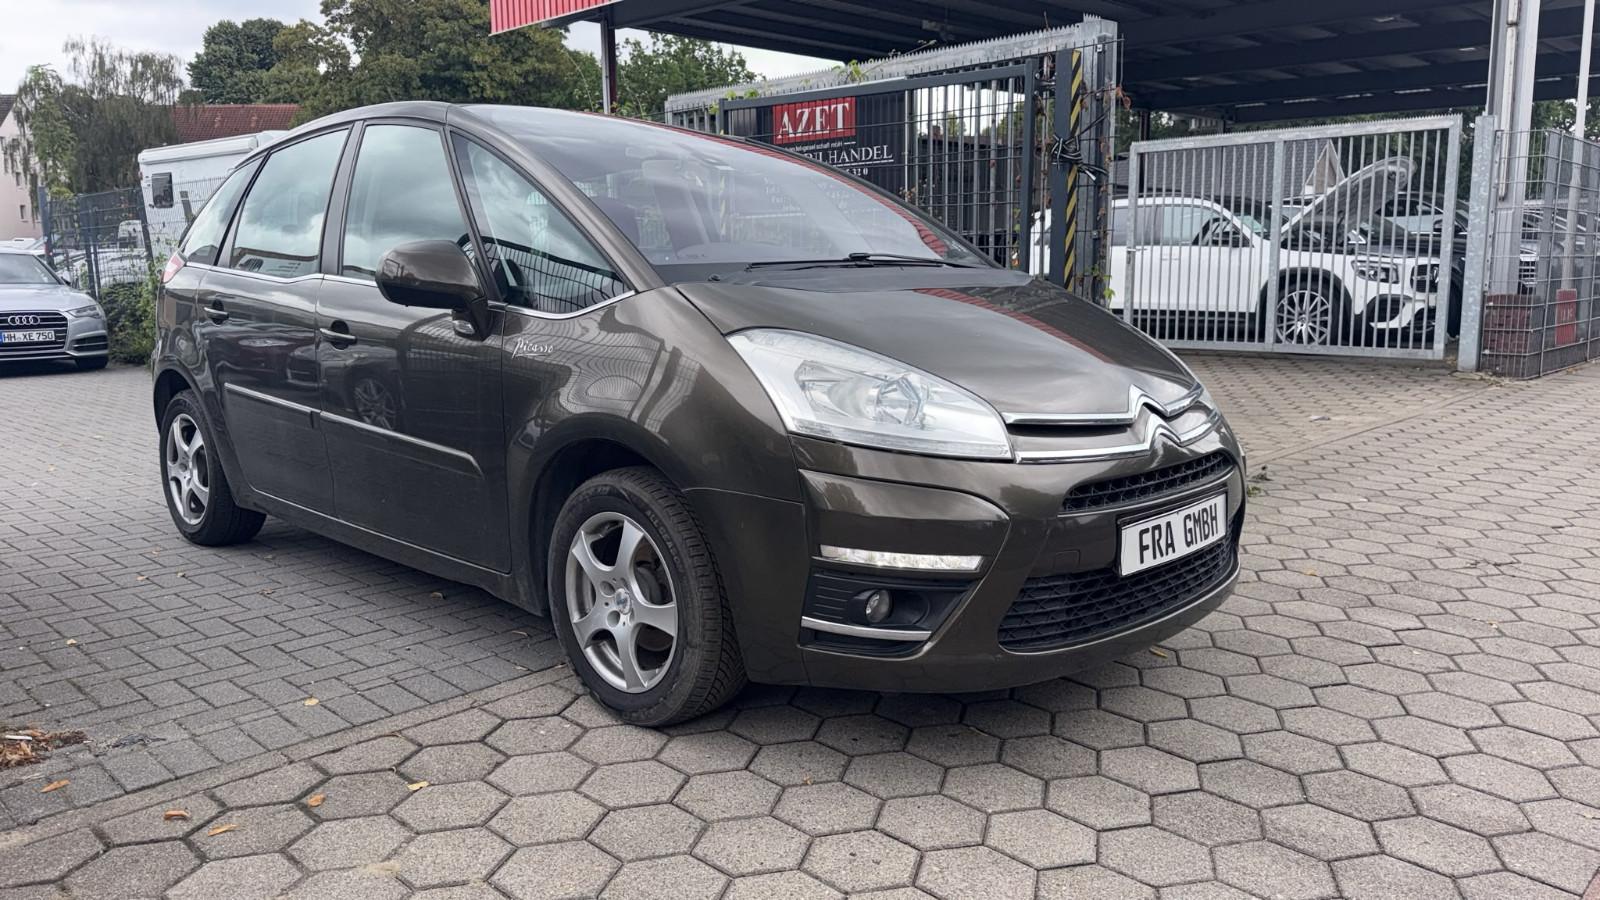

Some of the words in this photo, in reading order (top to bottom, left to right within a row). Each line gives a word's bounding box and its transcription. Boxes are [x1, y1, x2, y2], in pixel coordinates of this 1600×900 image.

[777, 103, 850, 139] AZET
[23, 332, 35, 341] XE
[36, 331, 54, 340] 750
[512, 337, 554, 359] Picasso
[1138, 521, 1176, 565] FRA
[1183, 503, 1219, 548] GMBH
